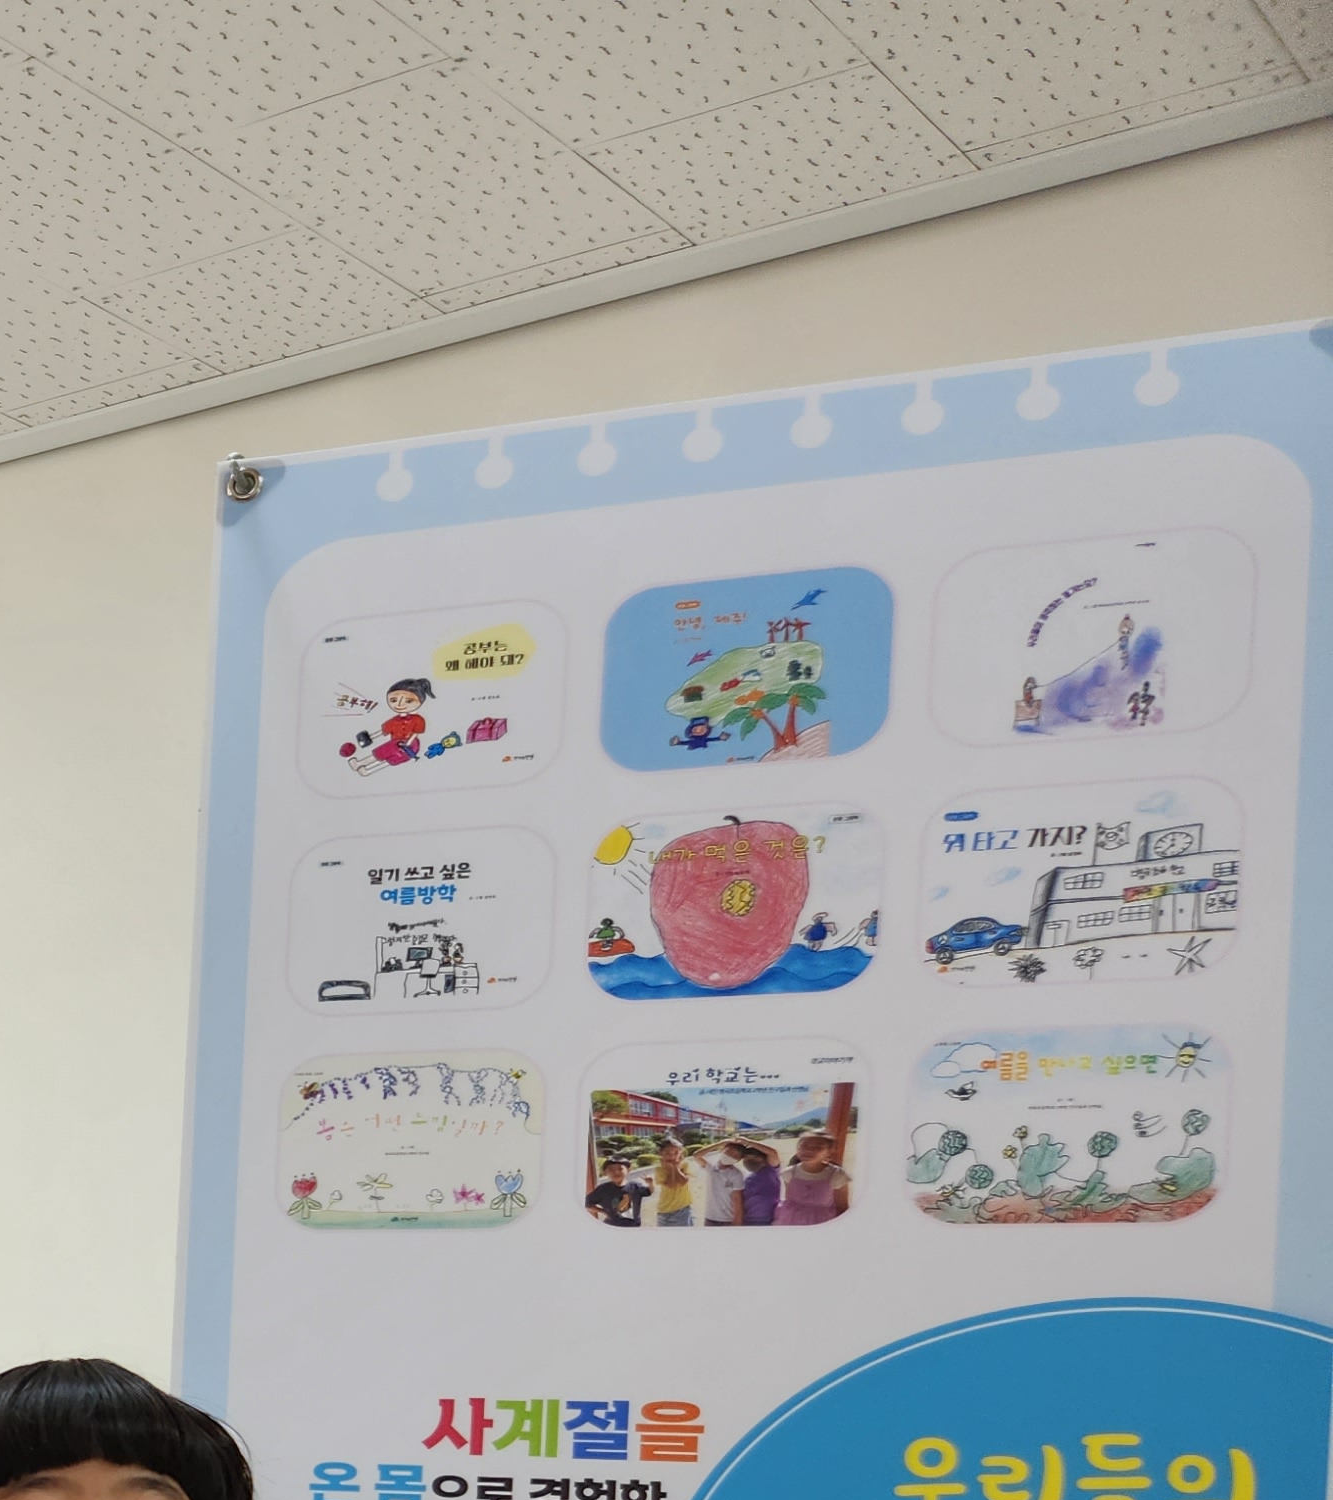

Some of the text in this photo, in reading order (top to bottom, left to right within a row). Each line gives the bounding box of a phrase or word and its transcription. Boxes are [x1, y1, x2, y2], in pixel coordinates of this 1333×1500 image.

[462, 640, 508, 656] 공부는
[444, 659, 460, 672] 왜
[464, 656, 494, 670] 해야
[971, 829, 1019, 851] 타고
[1026, 825, 1088, 848] 가지?
[648, 835, 826, 865] 내가 먹은 것은?
[367, 862, 472, 885] 일기 쓰고 싶은
[379, 884, 457, 906] 여름방학
[664, 1068, 700, 1087] 우리
[422, 1397, 706, 1463] 사계절을
